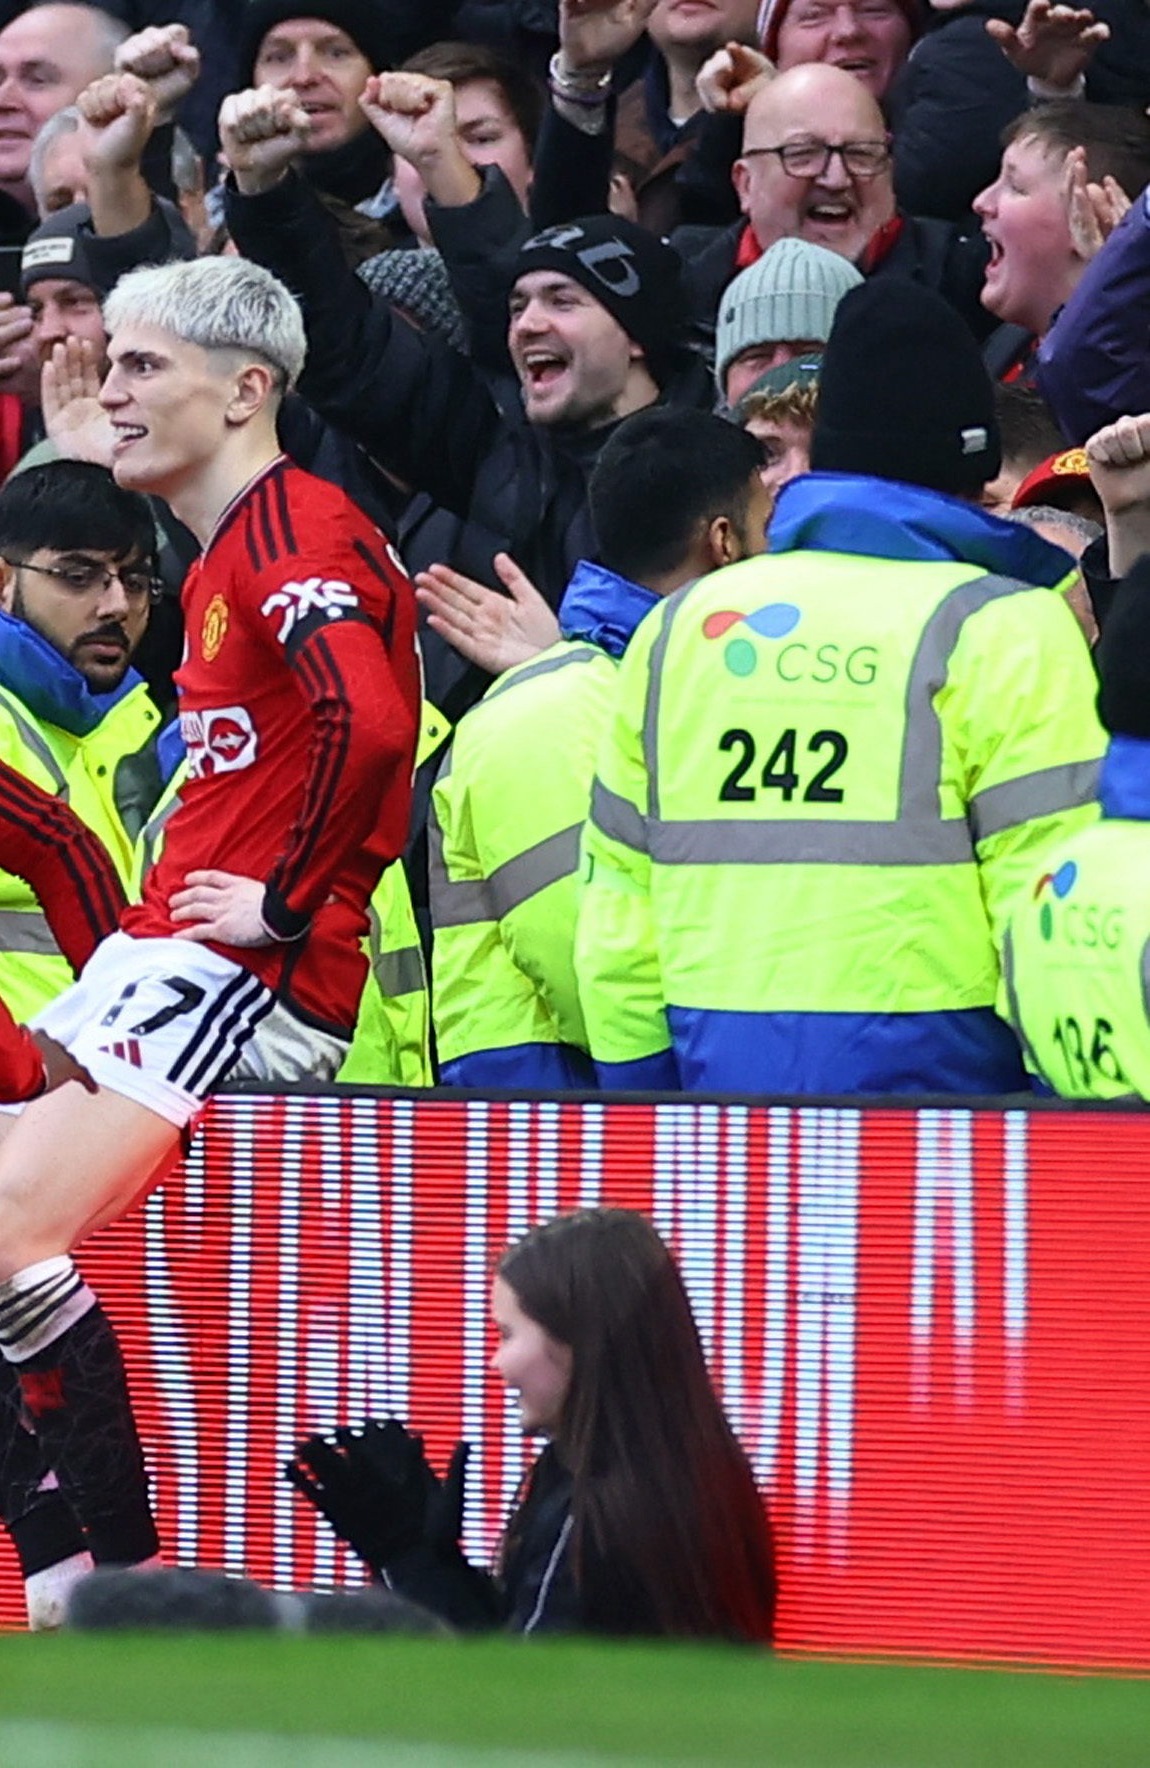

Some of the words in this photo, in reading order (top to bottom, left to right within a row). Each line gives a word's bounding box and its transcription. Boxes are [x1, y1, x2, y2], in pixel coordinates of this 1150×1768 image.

[776, 643, 879, 686] CSG
[717, 728, 849, 804] 242
[1064, 903, 1126, 950] CSG
[99, 975, 207, 1036] 17
